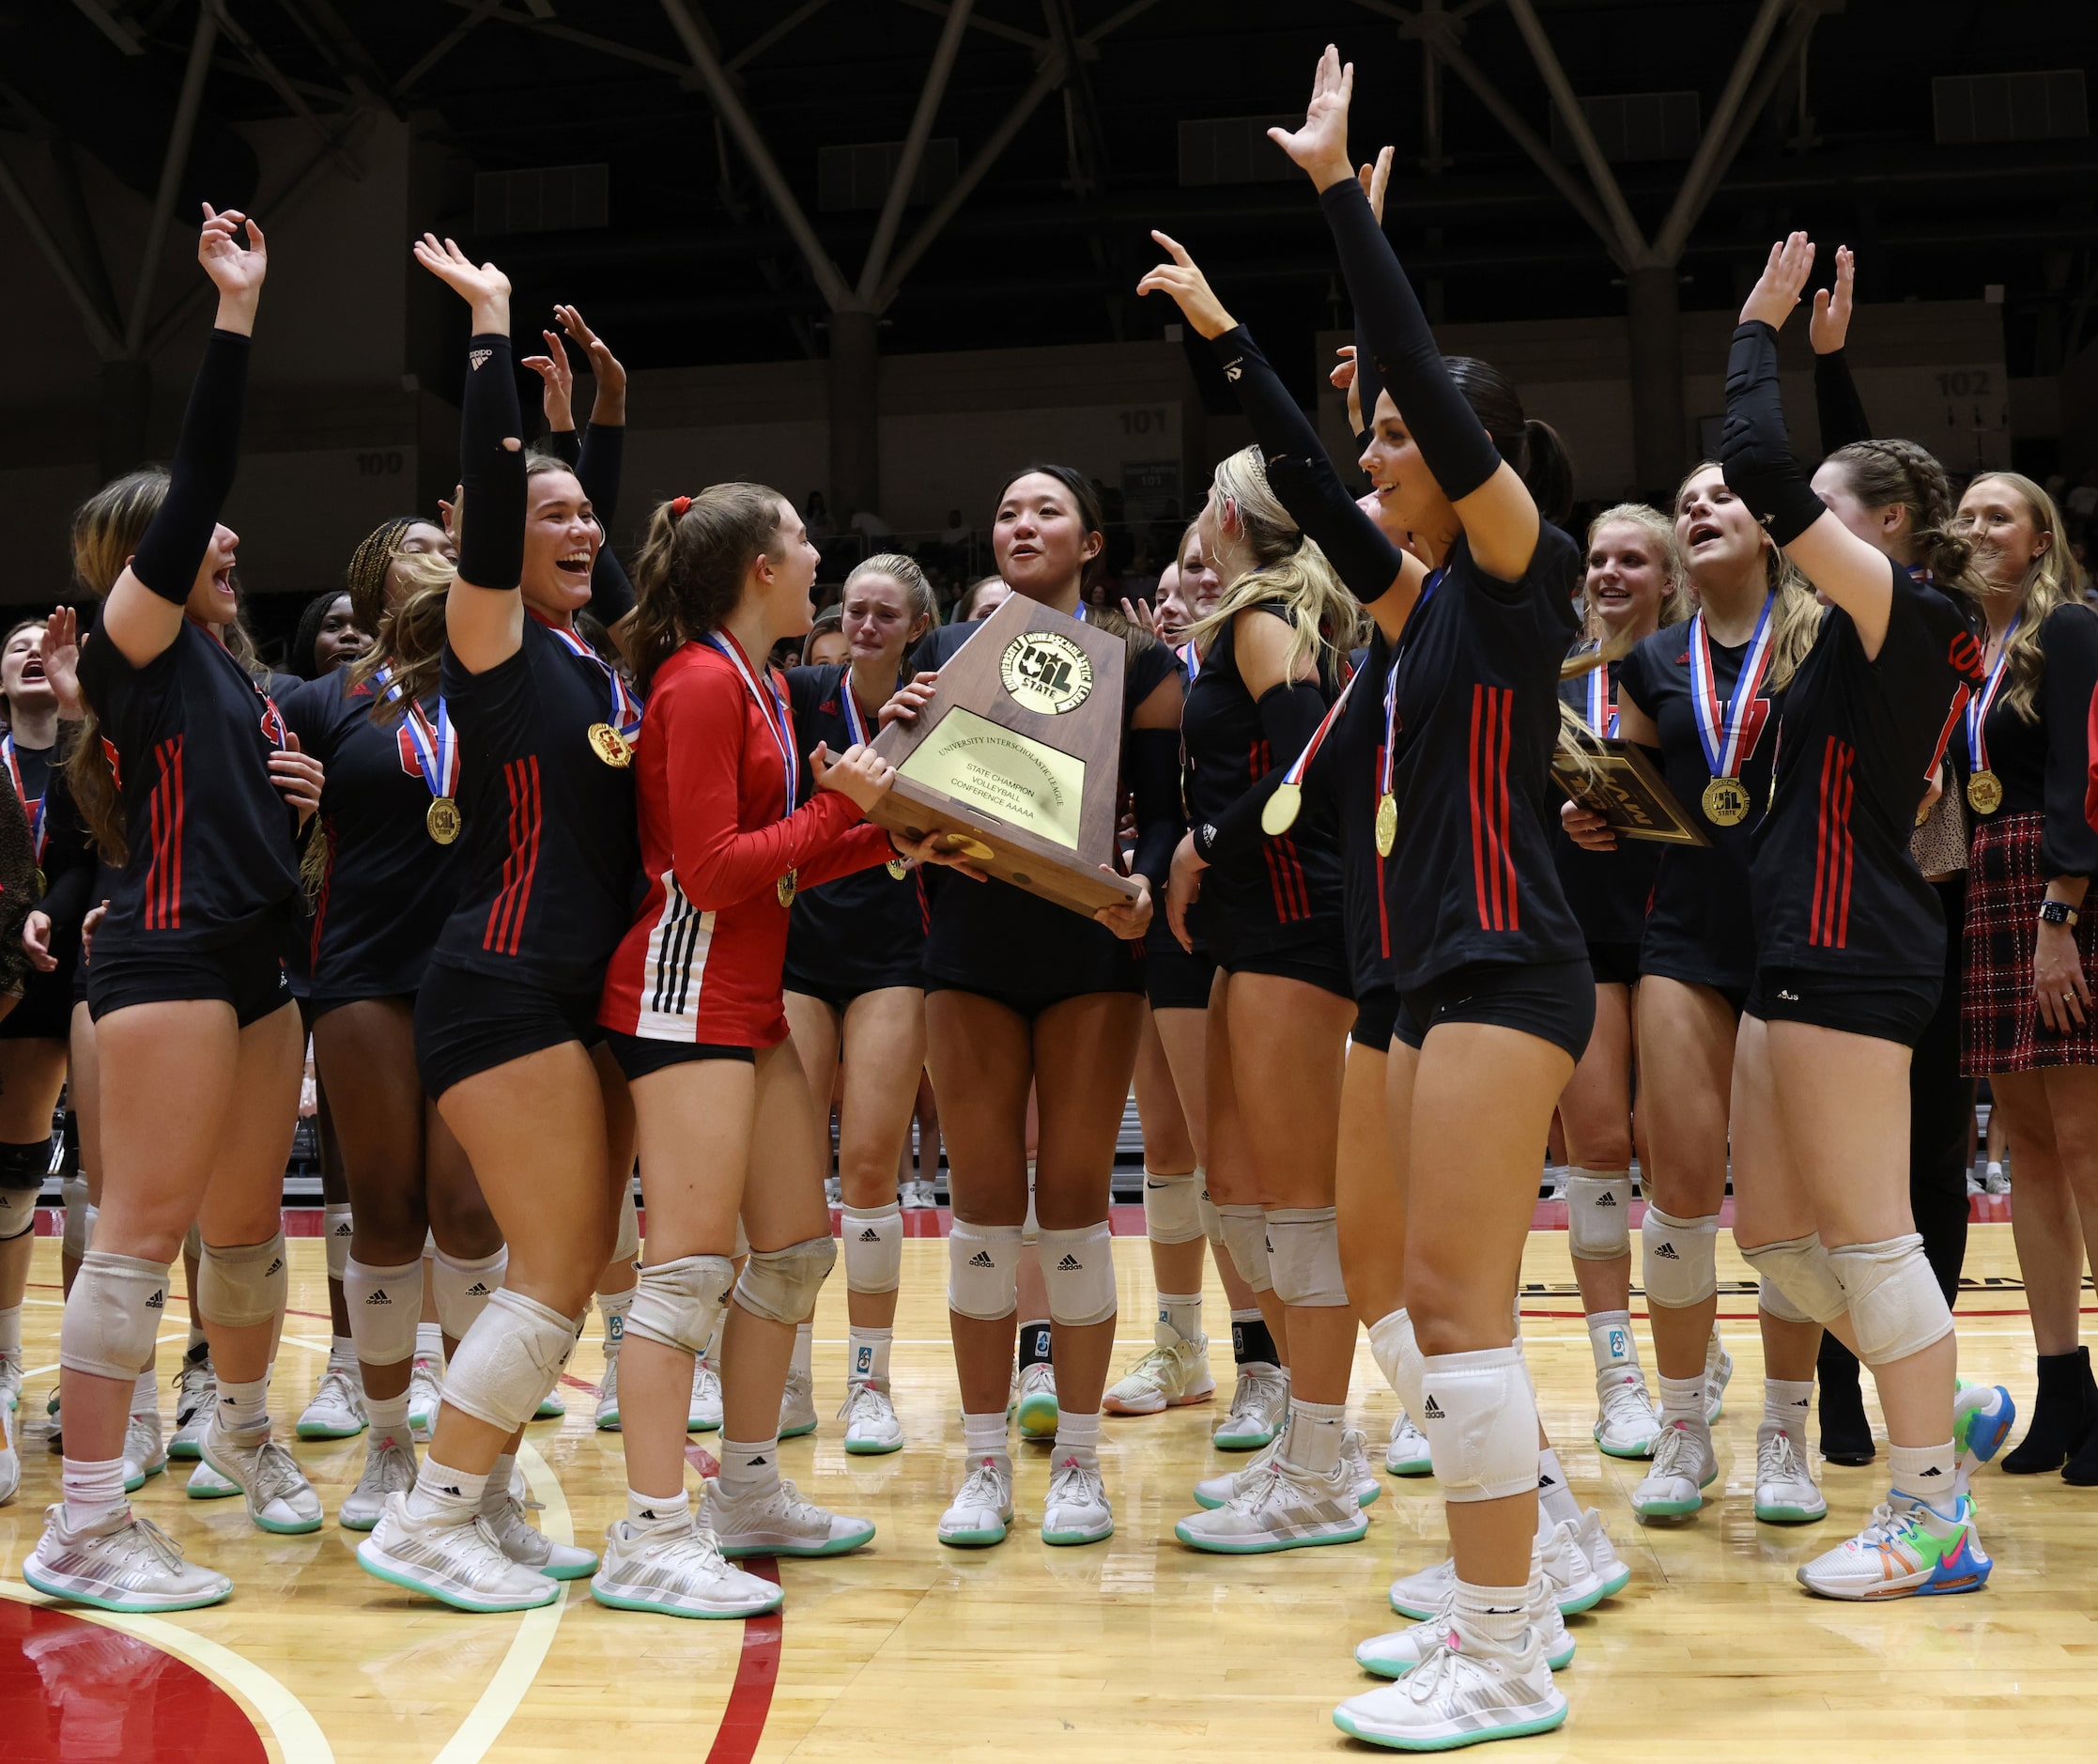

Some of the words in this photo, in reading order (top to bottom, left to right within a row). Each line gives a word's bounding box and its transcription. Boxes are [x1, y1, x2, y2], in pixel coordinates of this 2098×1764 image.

[1936, 370, 1991, 397] 102
[1118, 410, 1165, 435] 101
[356, 451, 404, 476] 100
[1019, 645, 1072, 695] UIL
[1021, 677, 1057, 699] STATE
[938, 736, 984, 756] UNIVERSITY
[986, 736, 1052, 778] INTERSCHOLASTIC
[1047, 776, 1064, 807] LEAGUE
[966, 763, 991, 778] STATE
[992, 774, 1035, 797] CHAMPION
[950, 778, 1005, 806] CONFERENCE
[1006, 802, 1034, 819] AAAAA
[972, 776, 1021, 802] VOLLEYBALL
[969, 1260, 995, 1268] adidas
[1654, 1249, 1680, 1260] adidas
